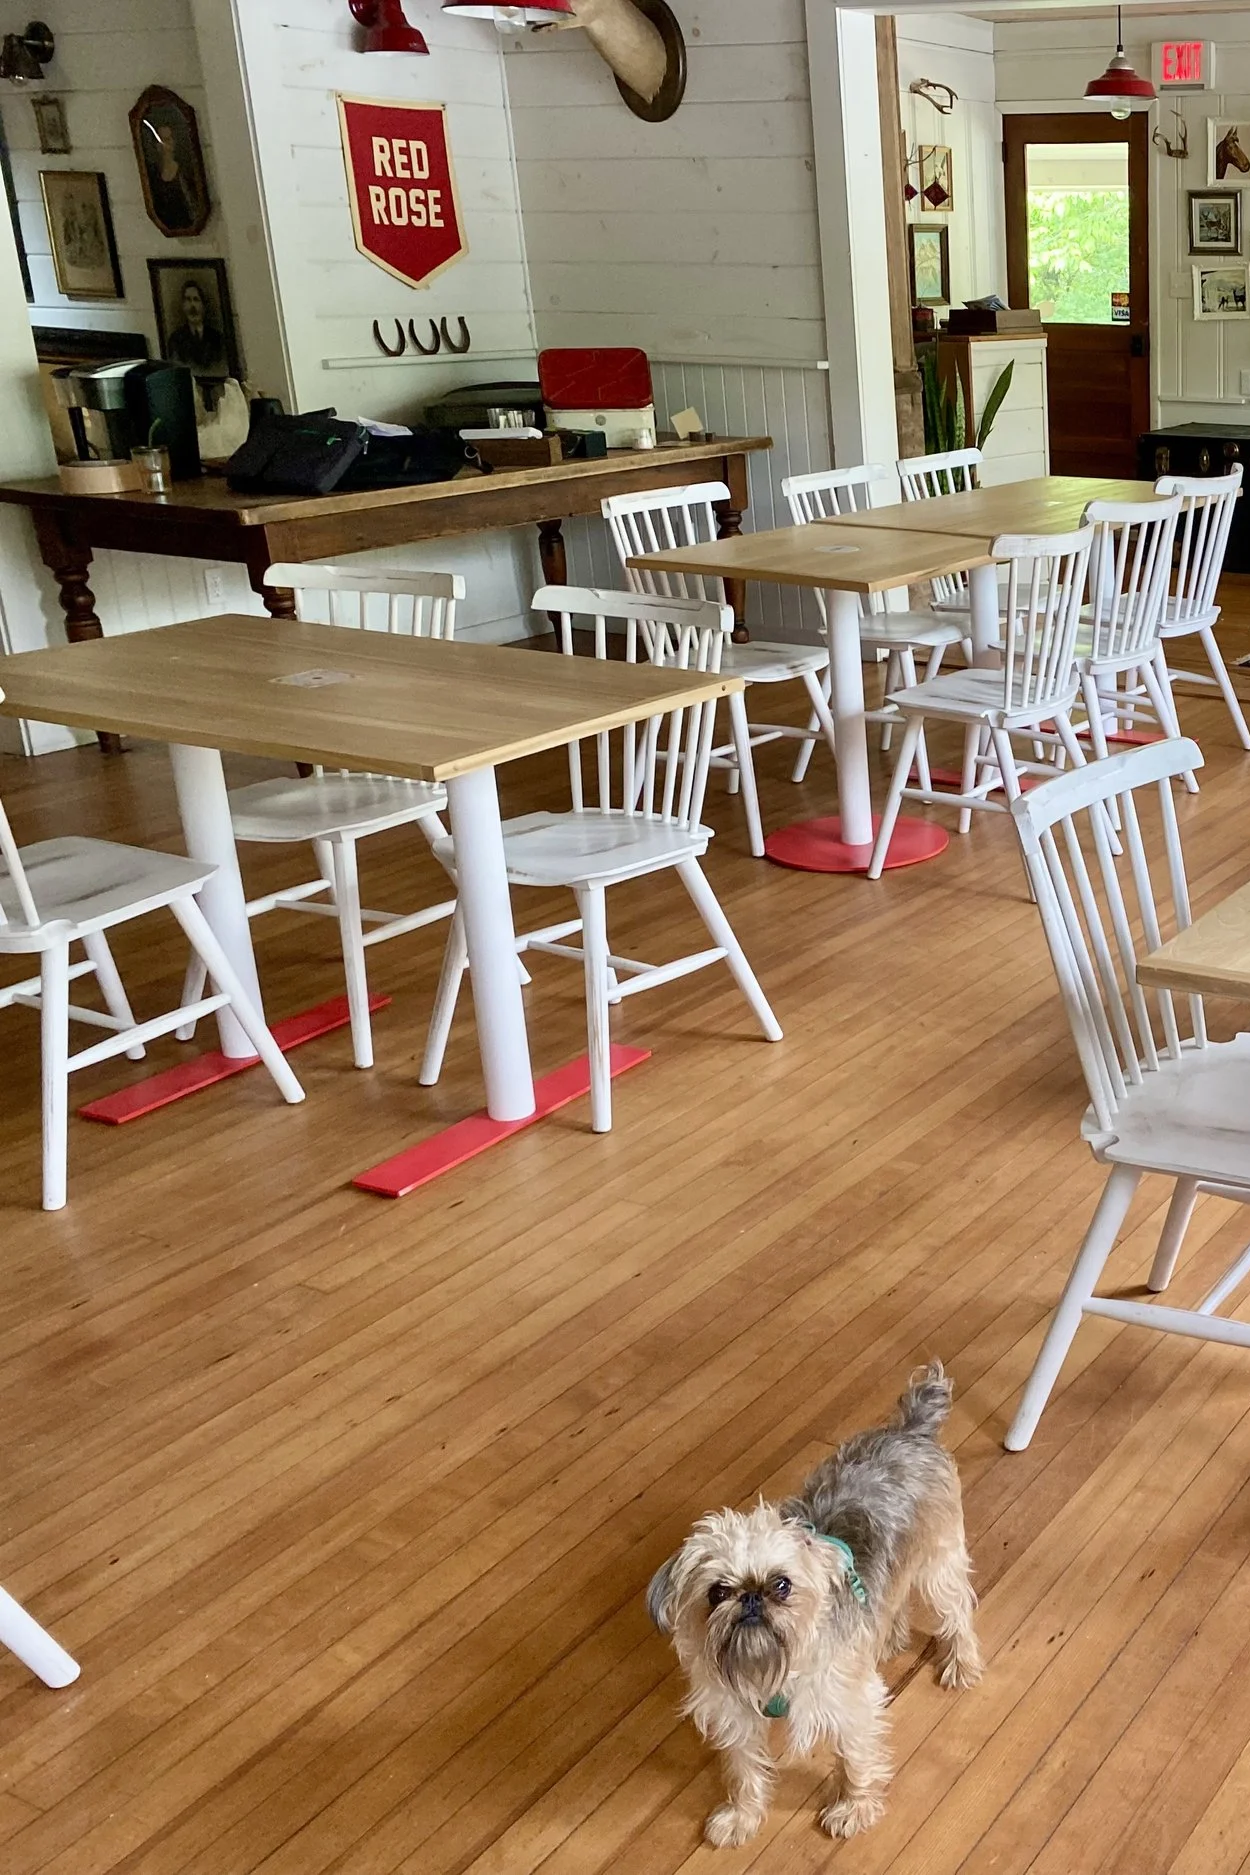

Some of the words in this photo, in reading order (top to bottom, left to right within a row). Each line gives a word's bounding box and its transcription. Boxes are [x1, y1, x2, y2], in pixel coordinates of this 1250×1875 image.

[1162, 42, 1204, 81] EXIT
[371, 137, 430, 180] RED
[368, 185, 444, 228] ROSE
[1114, 309, 1130, 317] VISA
